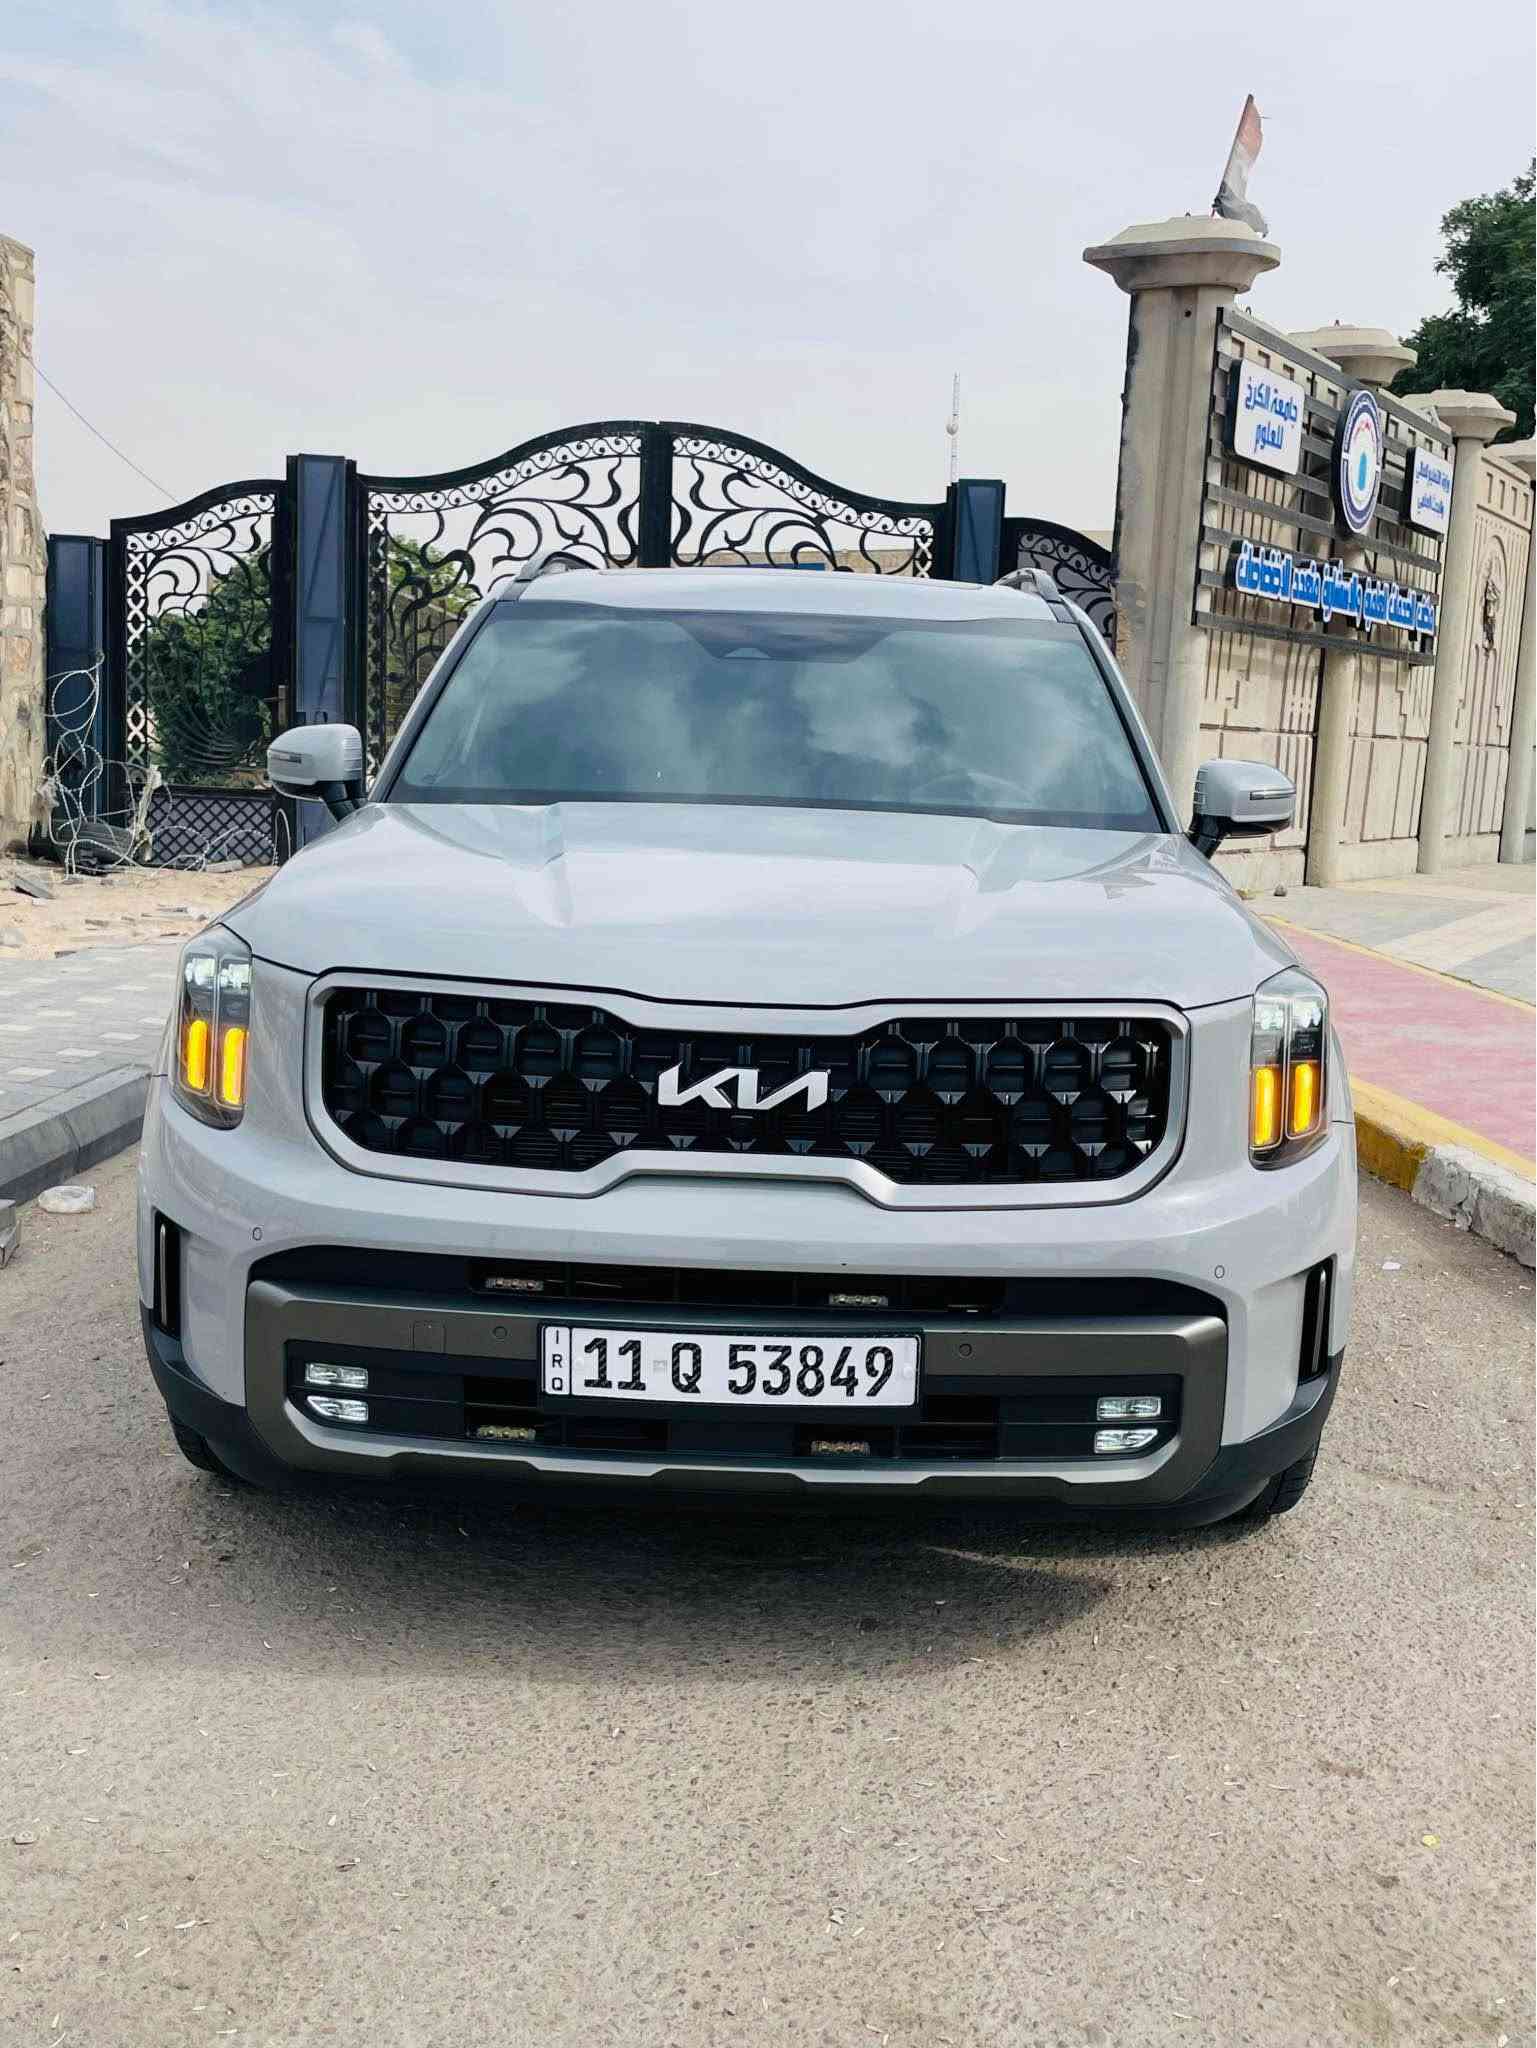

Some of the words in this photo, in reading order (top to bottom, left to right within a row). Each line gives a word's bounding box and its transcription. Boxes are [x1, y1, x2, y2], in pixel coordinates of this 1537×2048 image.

[1245, 377, 1271, 410] الكرخ
[1270, 388, 1297, 428] جامعة
[1254, 421, 1284, 455] للعلوم
[658, 1061, 830, 1112] KIA
[550, 1329, 564, 1392] IRQ
[584, 1337, 647, 1391] 11
[671, 1342, 702, 1394] Q
[728, 1344, 894, 1397] 53849
